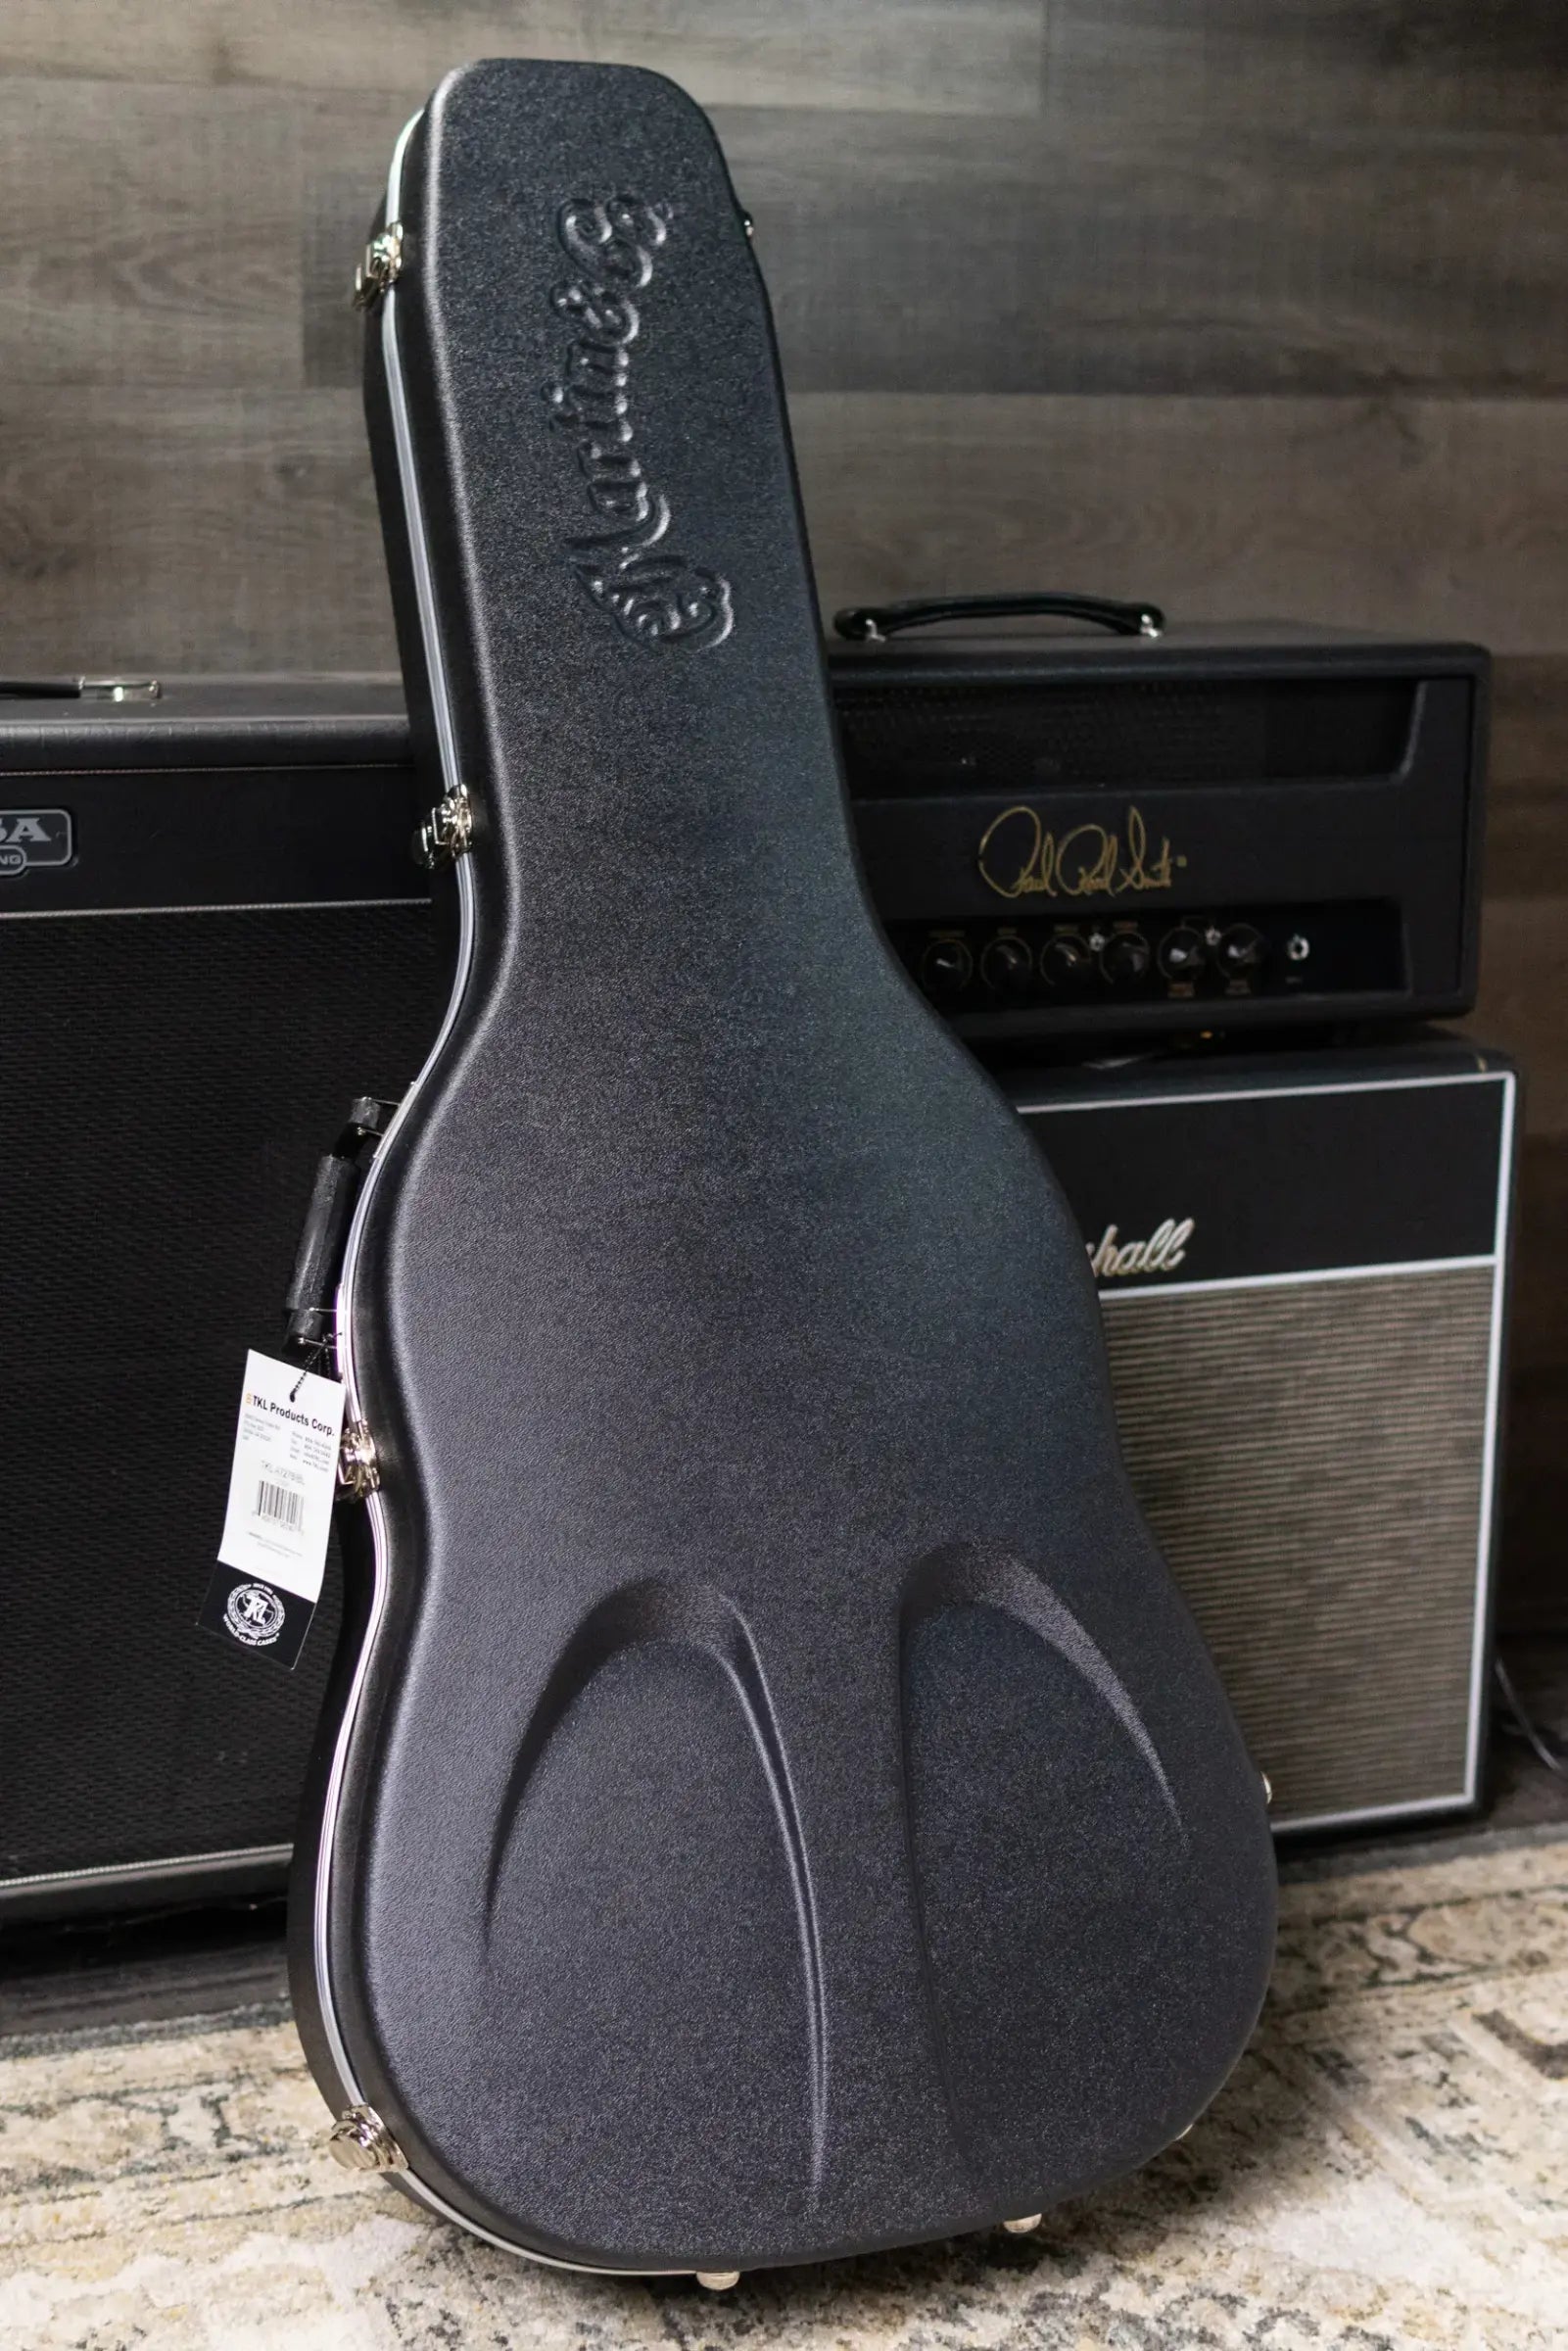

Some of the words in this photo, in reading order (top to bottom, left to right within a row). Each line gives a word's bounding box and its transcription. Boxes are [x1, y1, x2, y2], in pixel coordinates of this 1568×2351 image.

[0, 817, 52, 842] A
[253, 1395, 268, 1411] TKL
[269, 1402, 309, 1426] Products
[311, 1418, 335, 1437] Corp.
